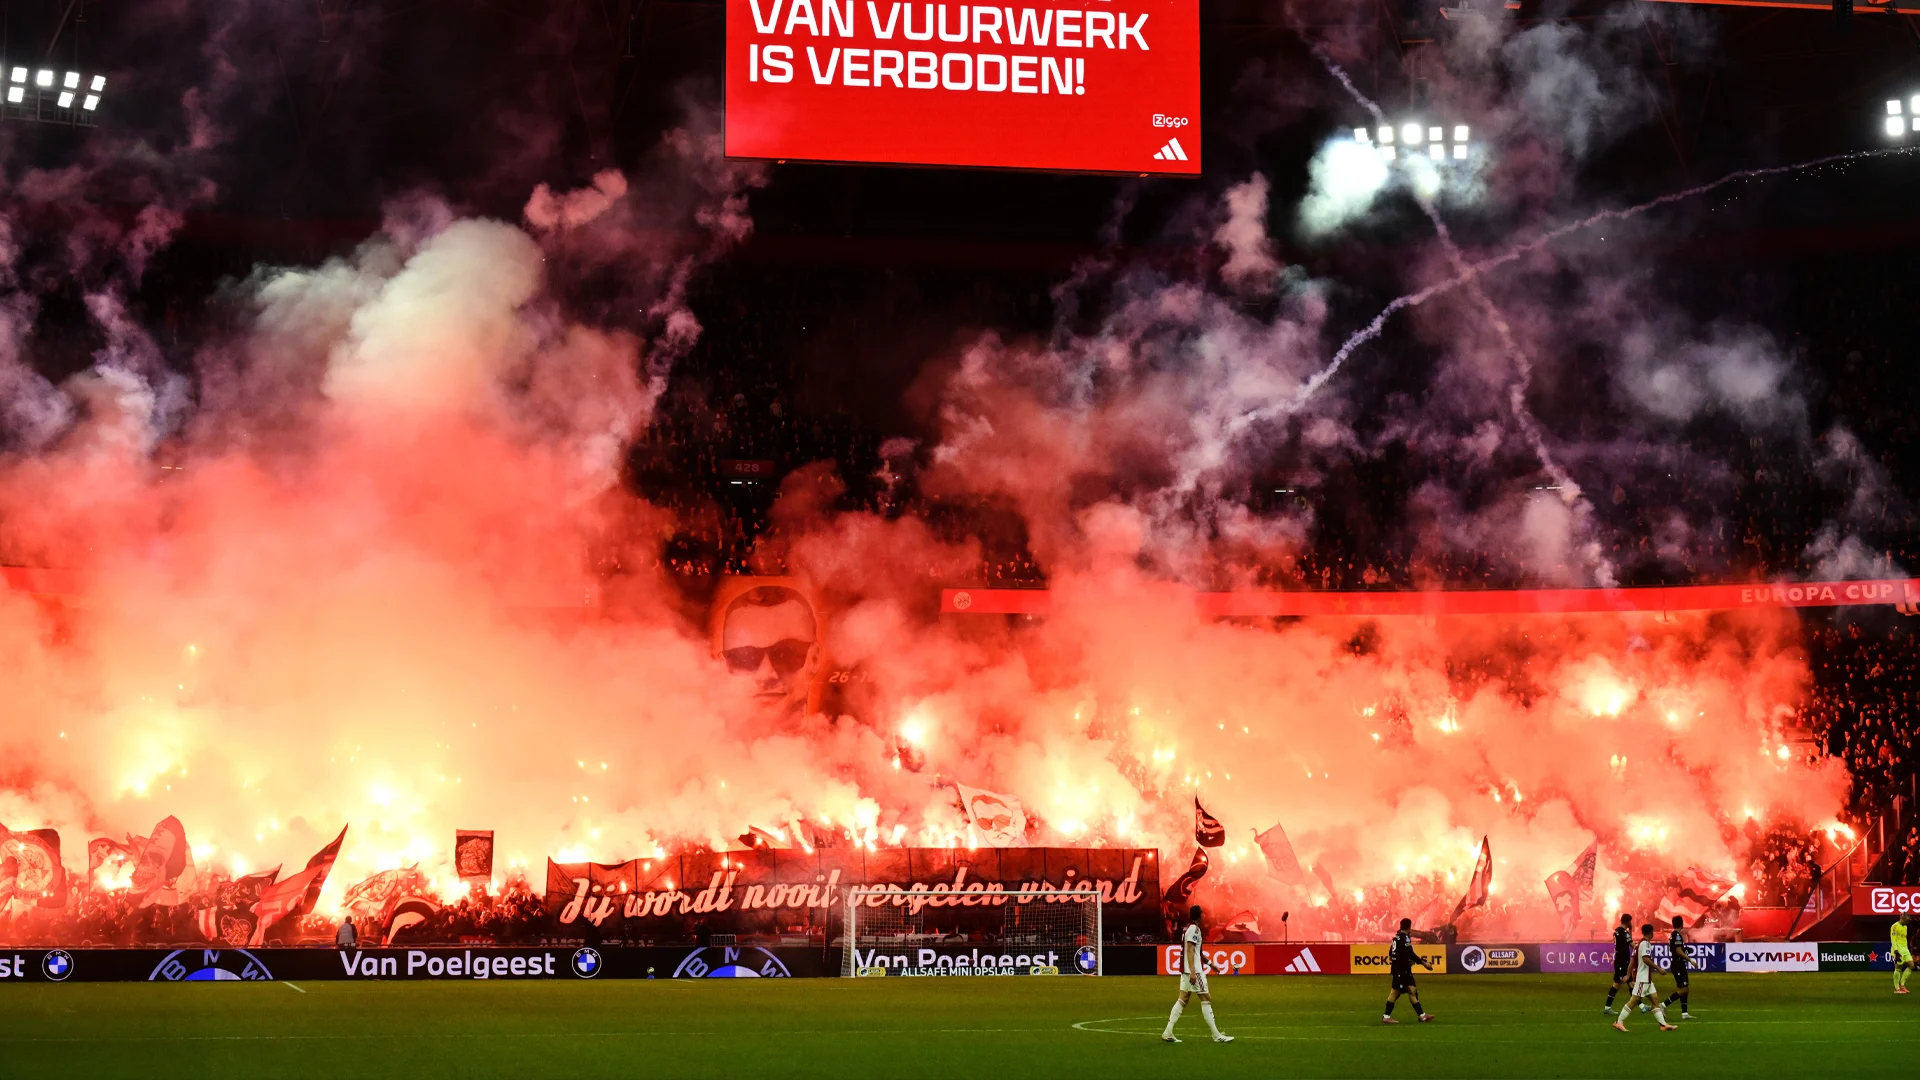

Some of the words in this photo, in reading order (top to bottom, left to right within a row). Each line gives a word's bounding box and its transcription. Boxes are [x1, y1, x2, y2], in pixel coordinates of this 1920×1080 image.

[750, 0, 854, 37] VAN
[866, 2, 1150, 50] VUURWERK
[749, 44, 793, 82] IS
[806, 46, 1086, 95] VERBODEN!
[1741, 586, 1836, 603] EUROPA
[1845, 584, 1894, 600] CUP
[623, 869, 736, 918] wordt
[741, 869, 841, 910] nooit
[848, 866, 1008, 915] vergeten
[1016, 856, 1143, 904] vriend
[854, 949, 908, 967] Van
[1491, 951, 1515, 959] ALLSAFE
[1546, 951, 1615, 966] CURAÇA
[1728, 952, 1815, 964] OLYMPIA
[1820, 952, 1866, 962] Heineken
[339, 950, 397, 976] Van
[407, 950, 556, 979] Poelgeest
[900, 967, 947, 977] ALLSAFE
[950, 967, 972, 976] MINI
[974, 967, 1015, 976] OPSLAG
